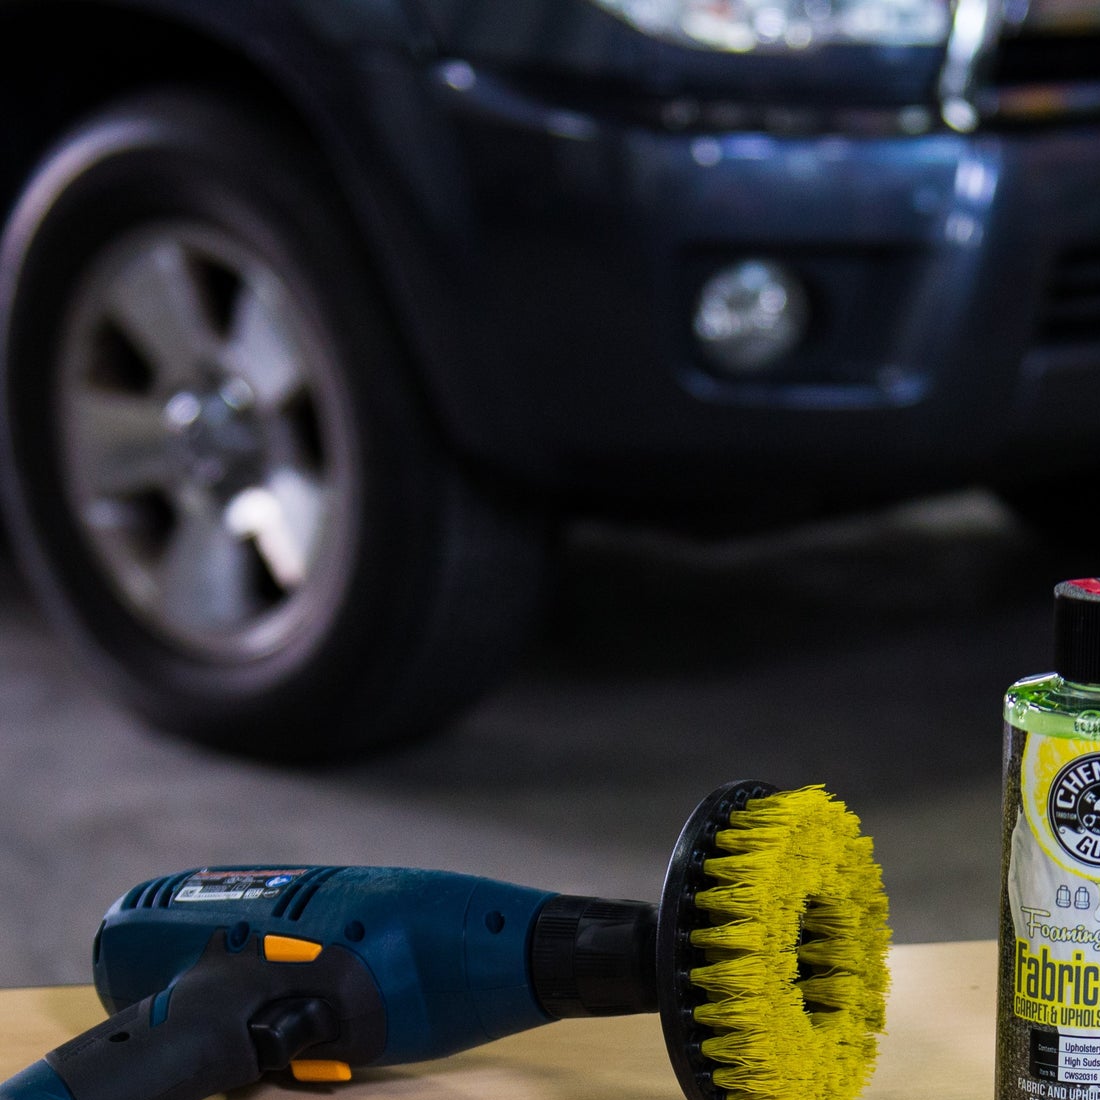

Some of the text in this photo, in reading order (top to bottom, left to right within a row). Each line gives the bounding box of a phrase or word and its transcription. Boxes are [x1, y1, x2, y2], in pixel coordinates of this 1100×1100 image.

[1016, 940, 1099, 1006] Fabric
[1015, 995, 1048, 1022] CARPET
[1050, 1006, 1057, 1024] &
[1064, 1056, 1081, 1067] High
[1082, 1057, 1100, 1067] Suds
[1064, 1071, 1098, 1081] CWS20316
[1017, 1077, 1046, 1096] FABRIC
[1048, 1086, 1067, 1099] AND
